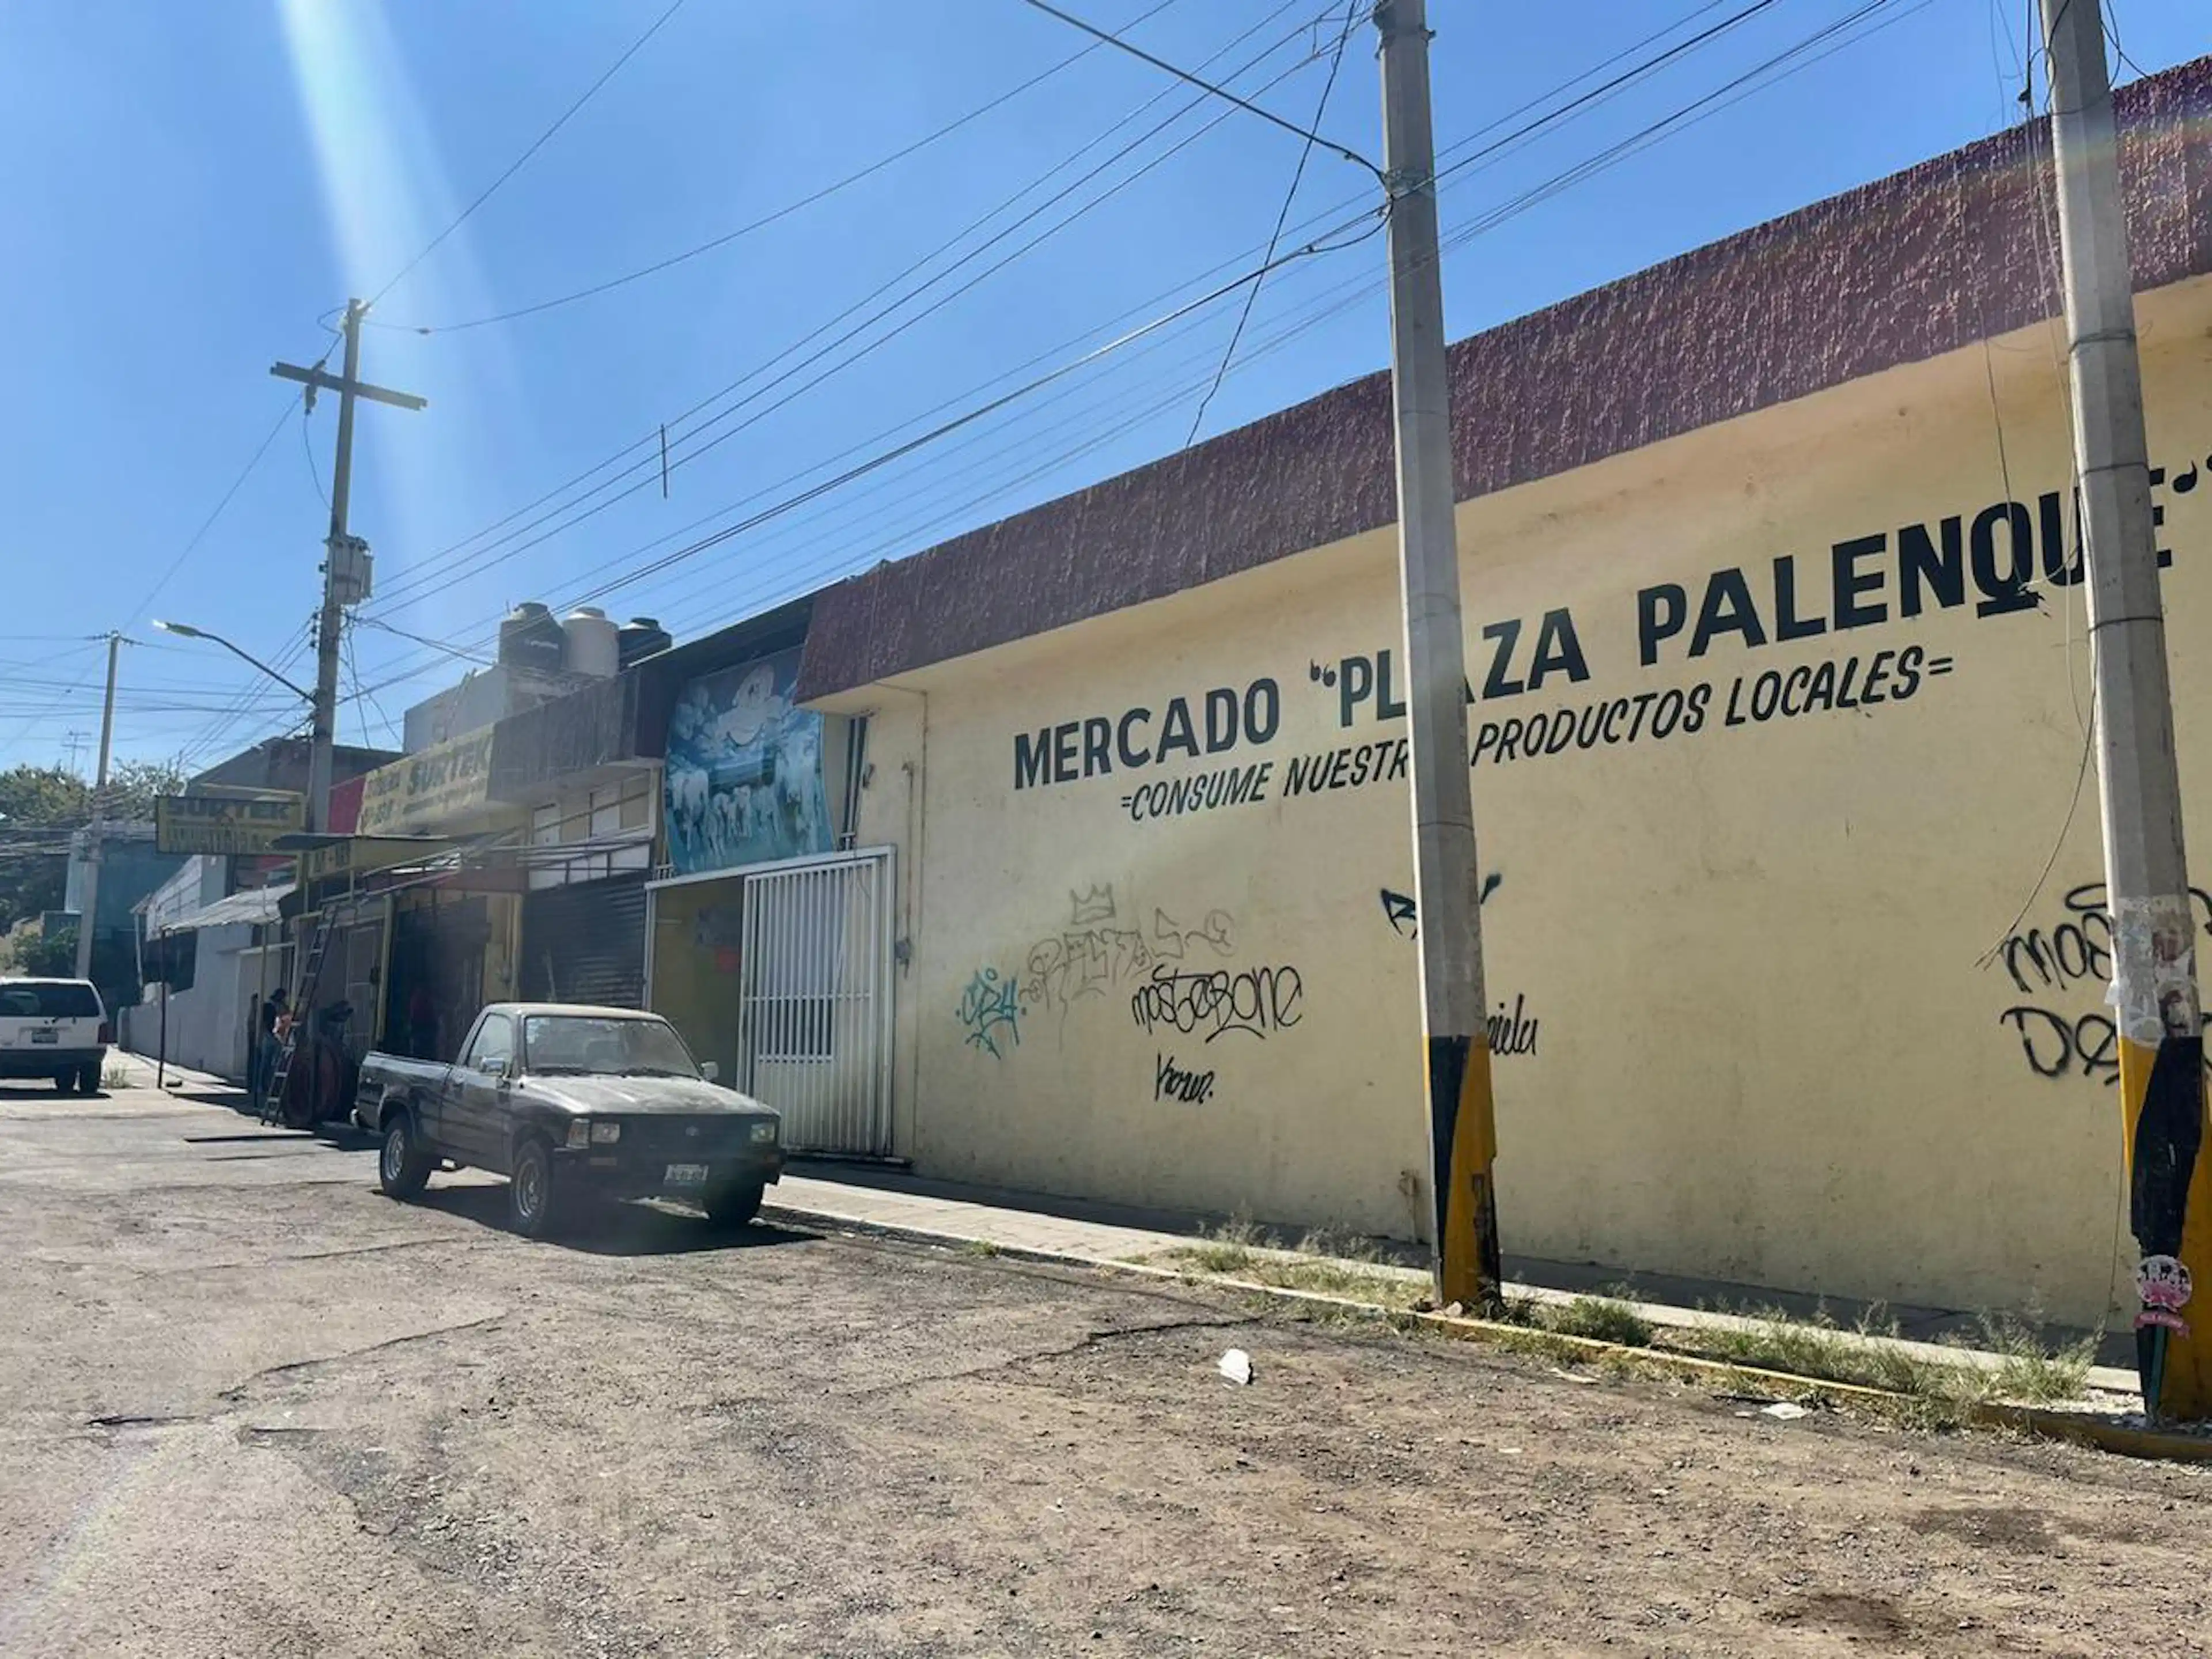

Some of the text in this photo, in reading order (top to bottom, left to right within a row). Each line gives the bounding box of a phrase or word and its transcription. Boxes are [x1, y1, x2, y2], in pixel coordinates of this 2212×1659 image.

[1014, 677, 1280, 791] MERCADO
[1309, 607, 1592, 729] "PLZA
[1283, 738, 1410, 797] NUESTR
[1470, 683, 1713, 767] PRODUCTOS
